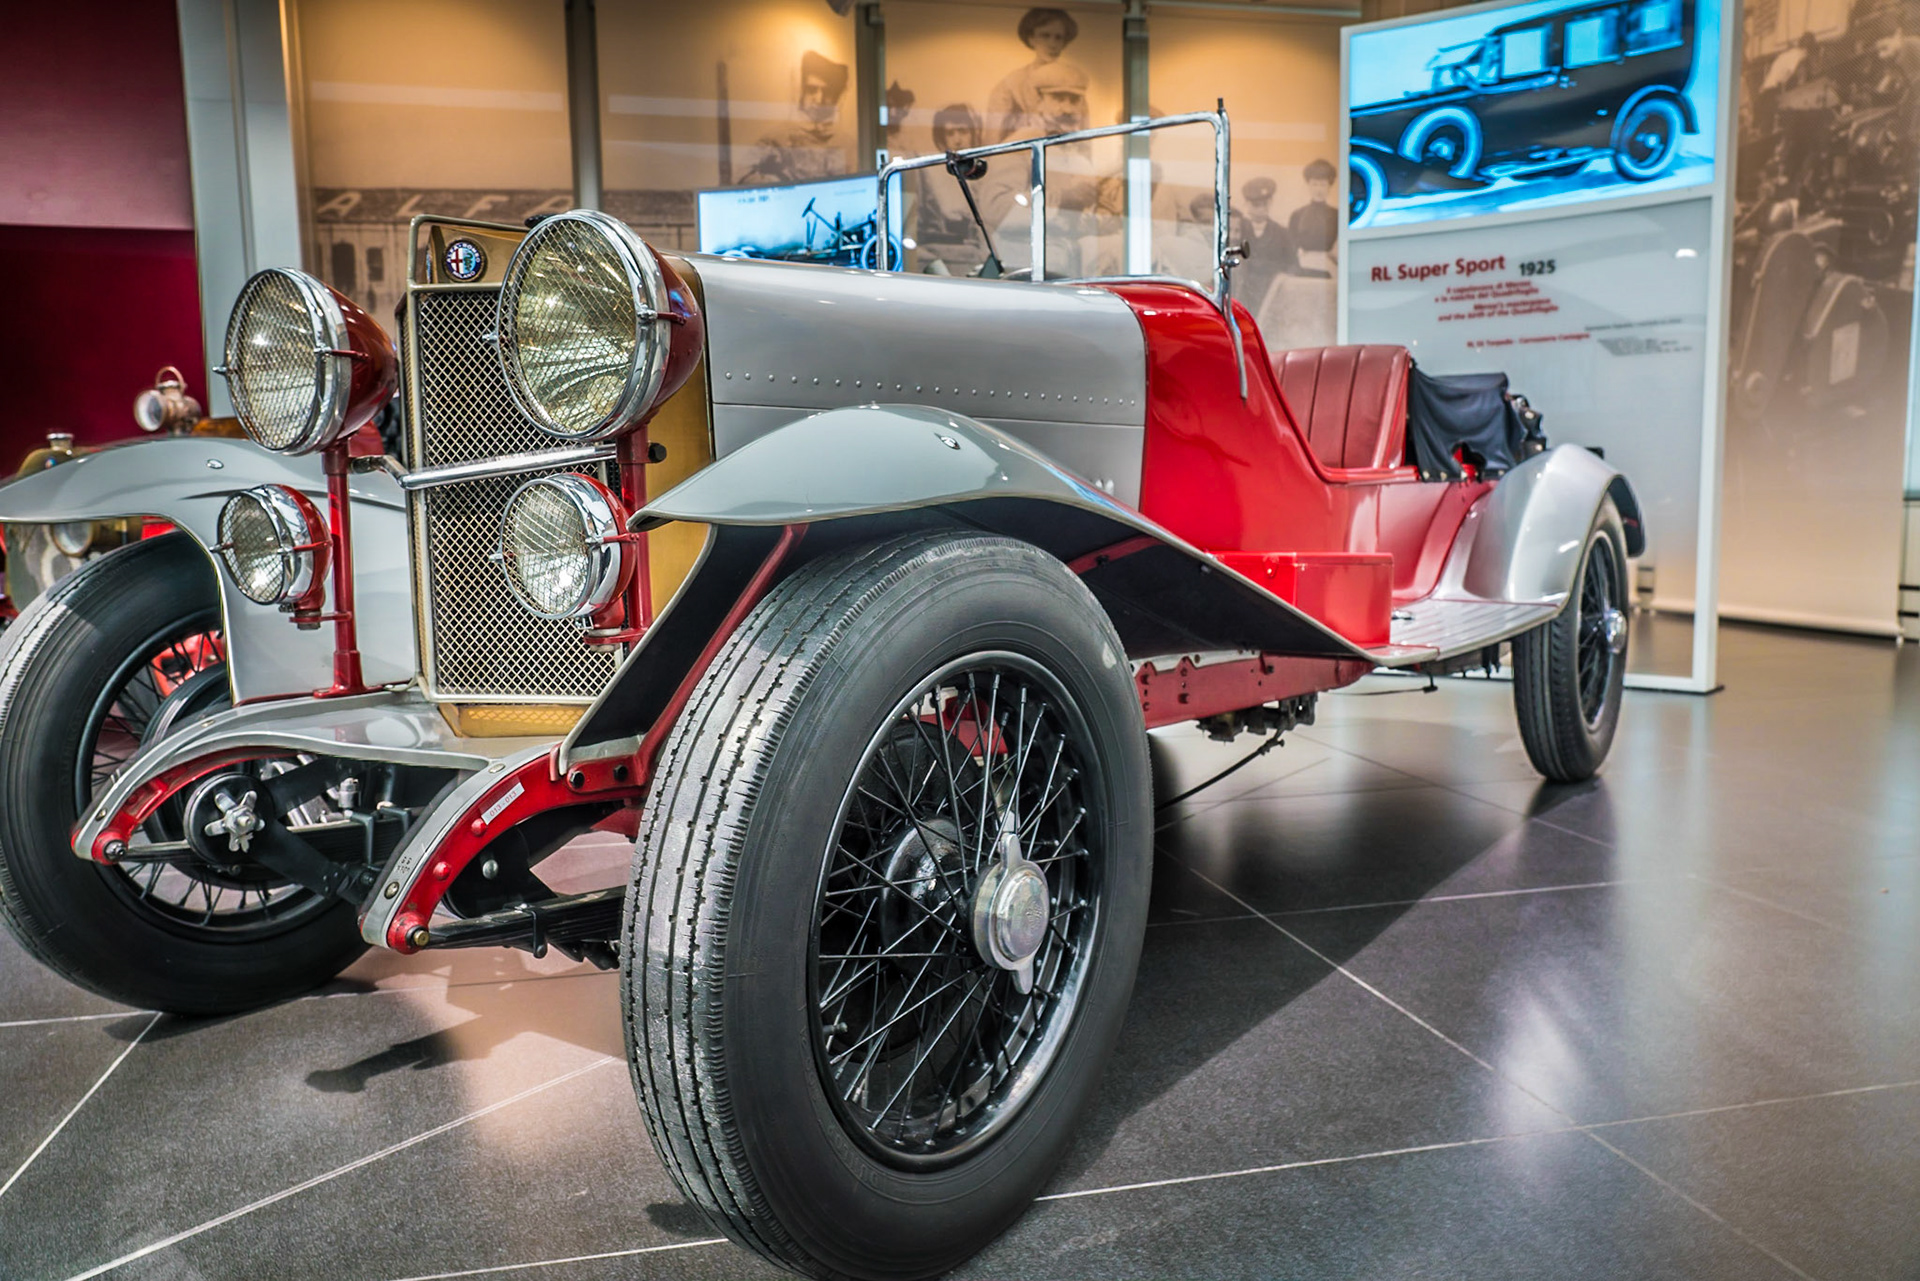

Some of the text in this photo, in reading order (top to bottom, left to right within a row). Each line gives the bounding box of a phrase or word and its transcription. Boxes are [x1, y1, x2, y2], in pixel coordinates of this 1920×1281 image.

[1371, 255, 1556, 282] RL Super Sport 1925
